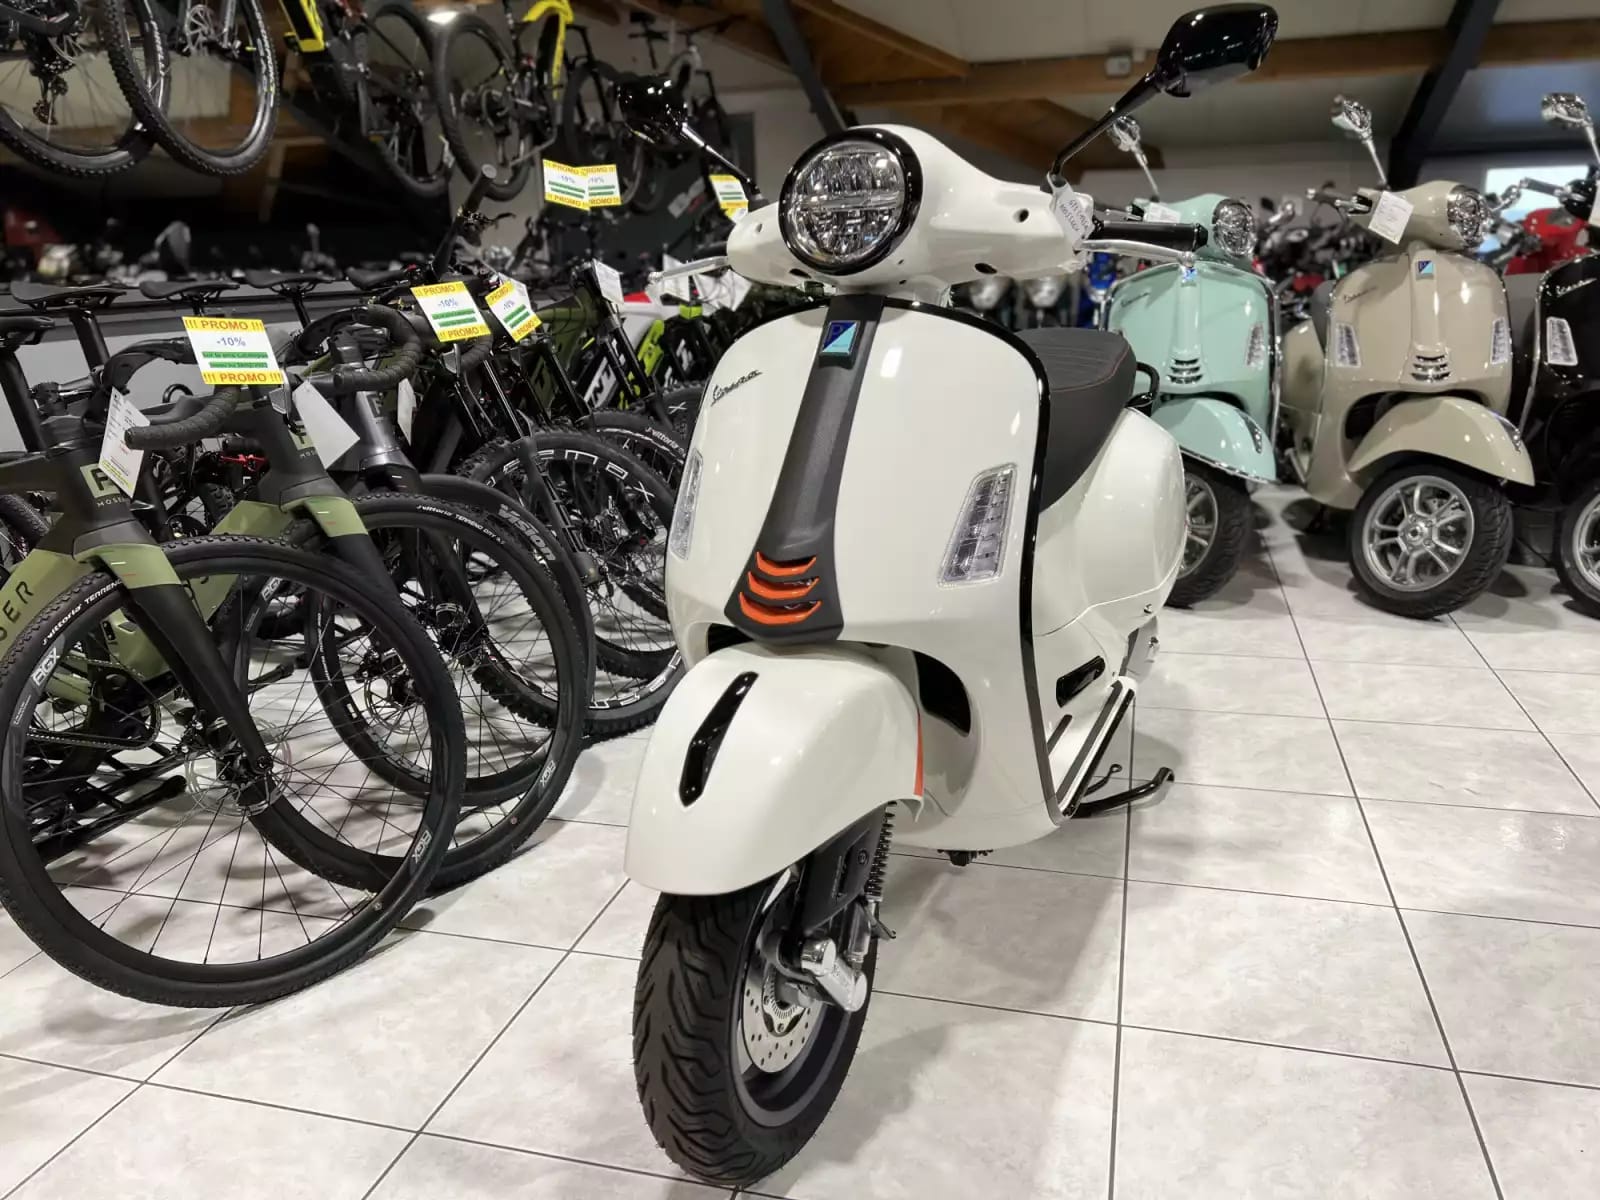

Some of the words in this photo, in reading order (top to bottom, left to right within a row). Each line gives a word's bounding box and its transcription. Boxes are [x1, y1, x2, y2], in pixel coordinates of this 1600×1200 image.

[423, 284, 456, 296] PROMO
[200, 319, 249, 330] PROMO
[447, 326, 481, 338] PROMO
[216, 336, 247, 347] -10%
[219, 372, 268, 382] PROMO
